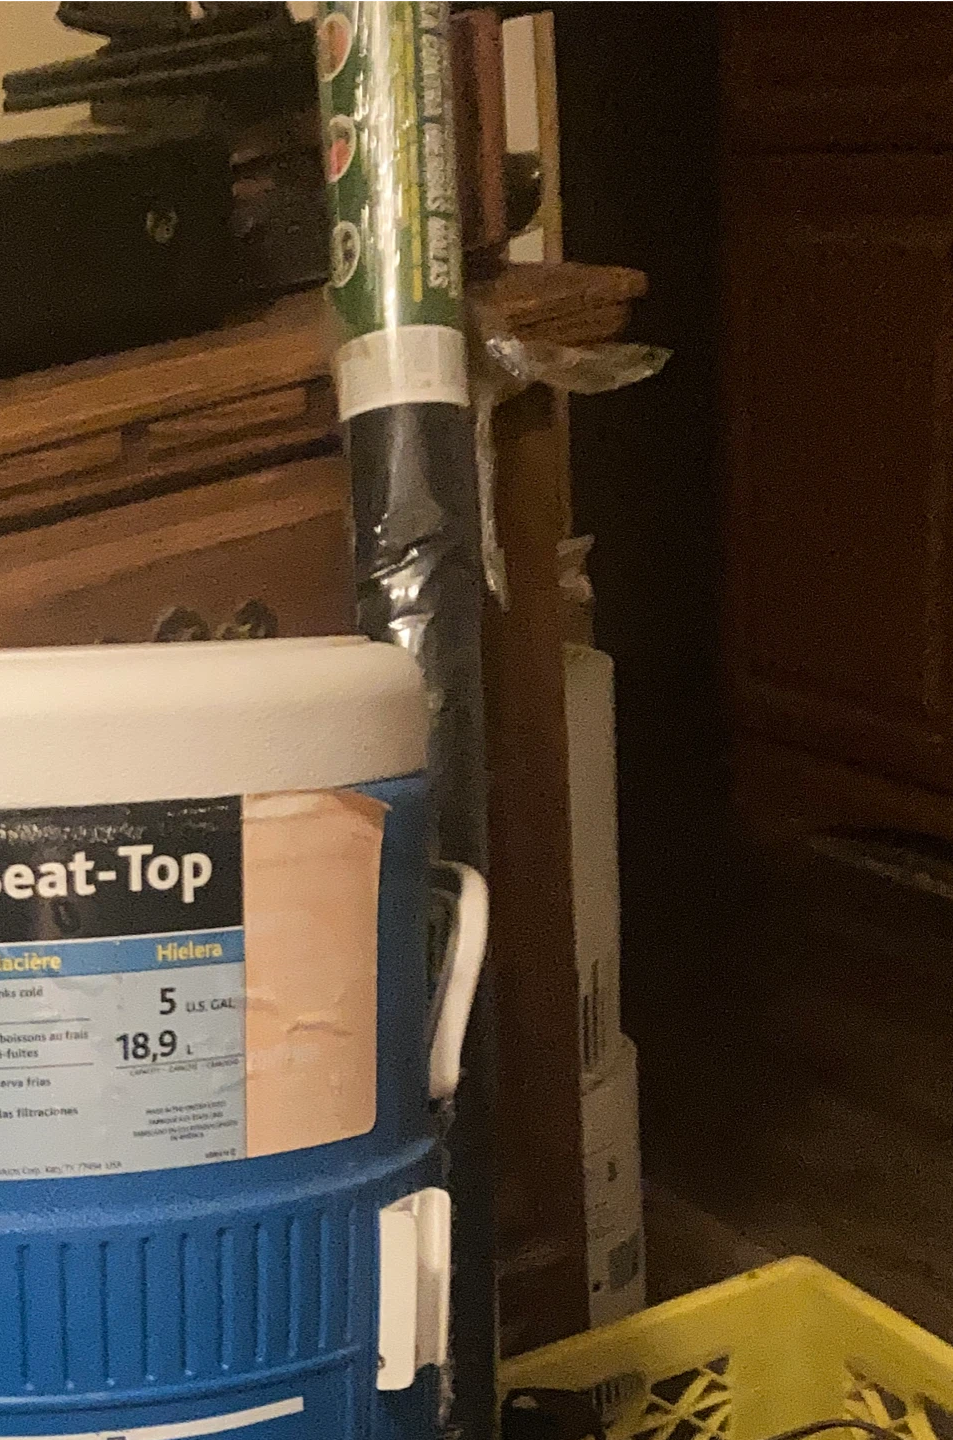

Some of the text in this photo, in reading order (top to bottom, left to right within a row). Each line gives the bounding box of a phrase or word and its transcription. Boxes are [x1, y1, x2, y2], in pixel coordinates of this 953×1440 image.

[156, 942, 223, 962] Hielera
[19, 986, 43, 997] cold
[159, 987, 176, 1015] 5
[0, 1033, 46, 1044] boissons
[49, 1032, 63, 1042] au
[115, 1030, 194, 1063] 18,9 L
[16, 1106, 79, 1118] filtraciones
